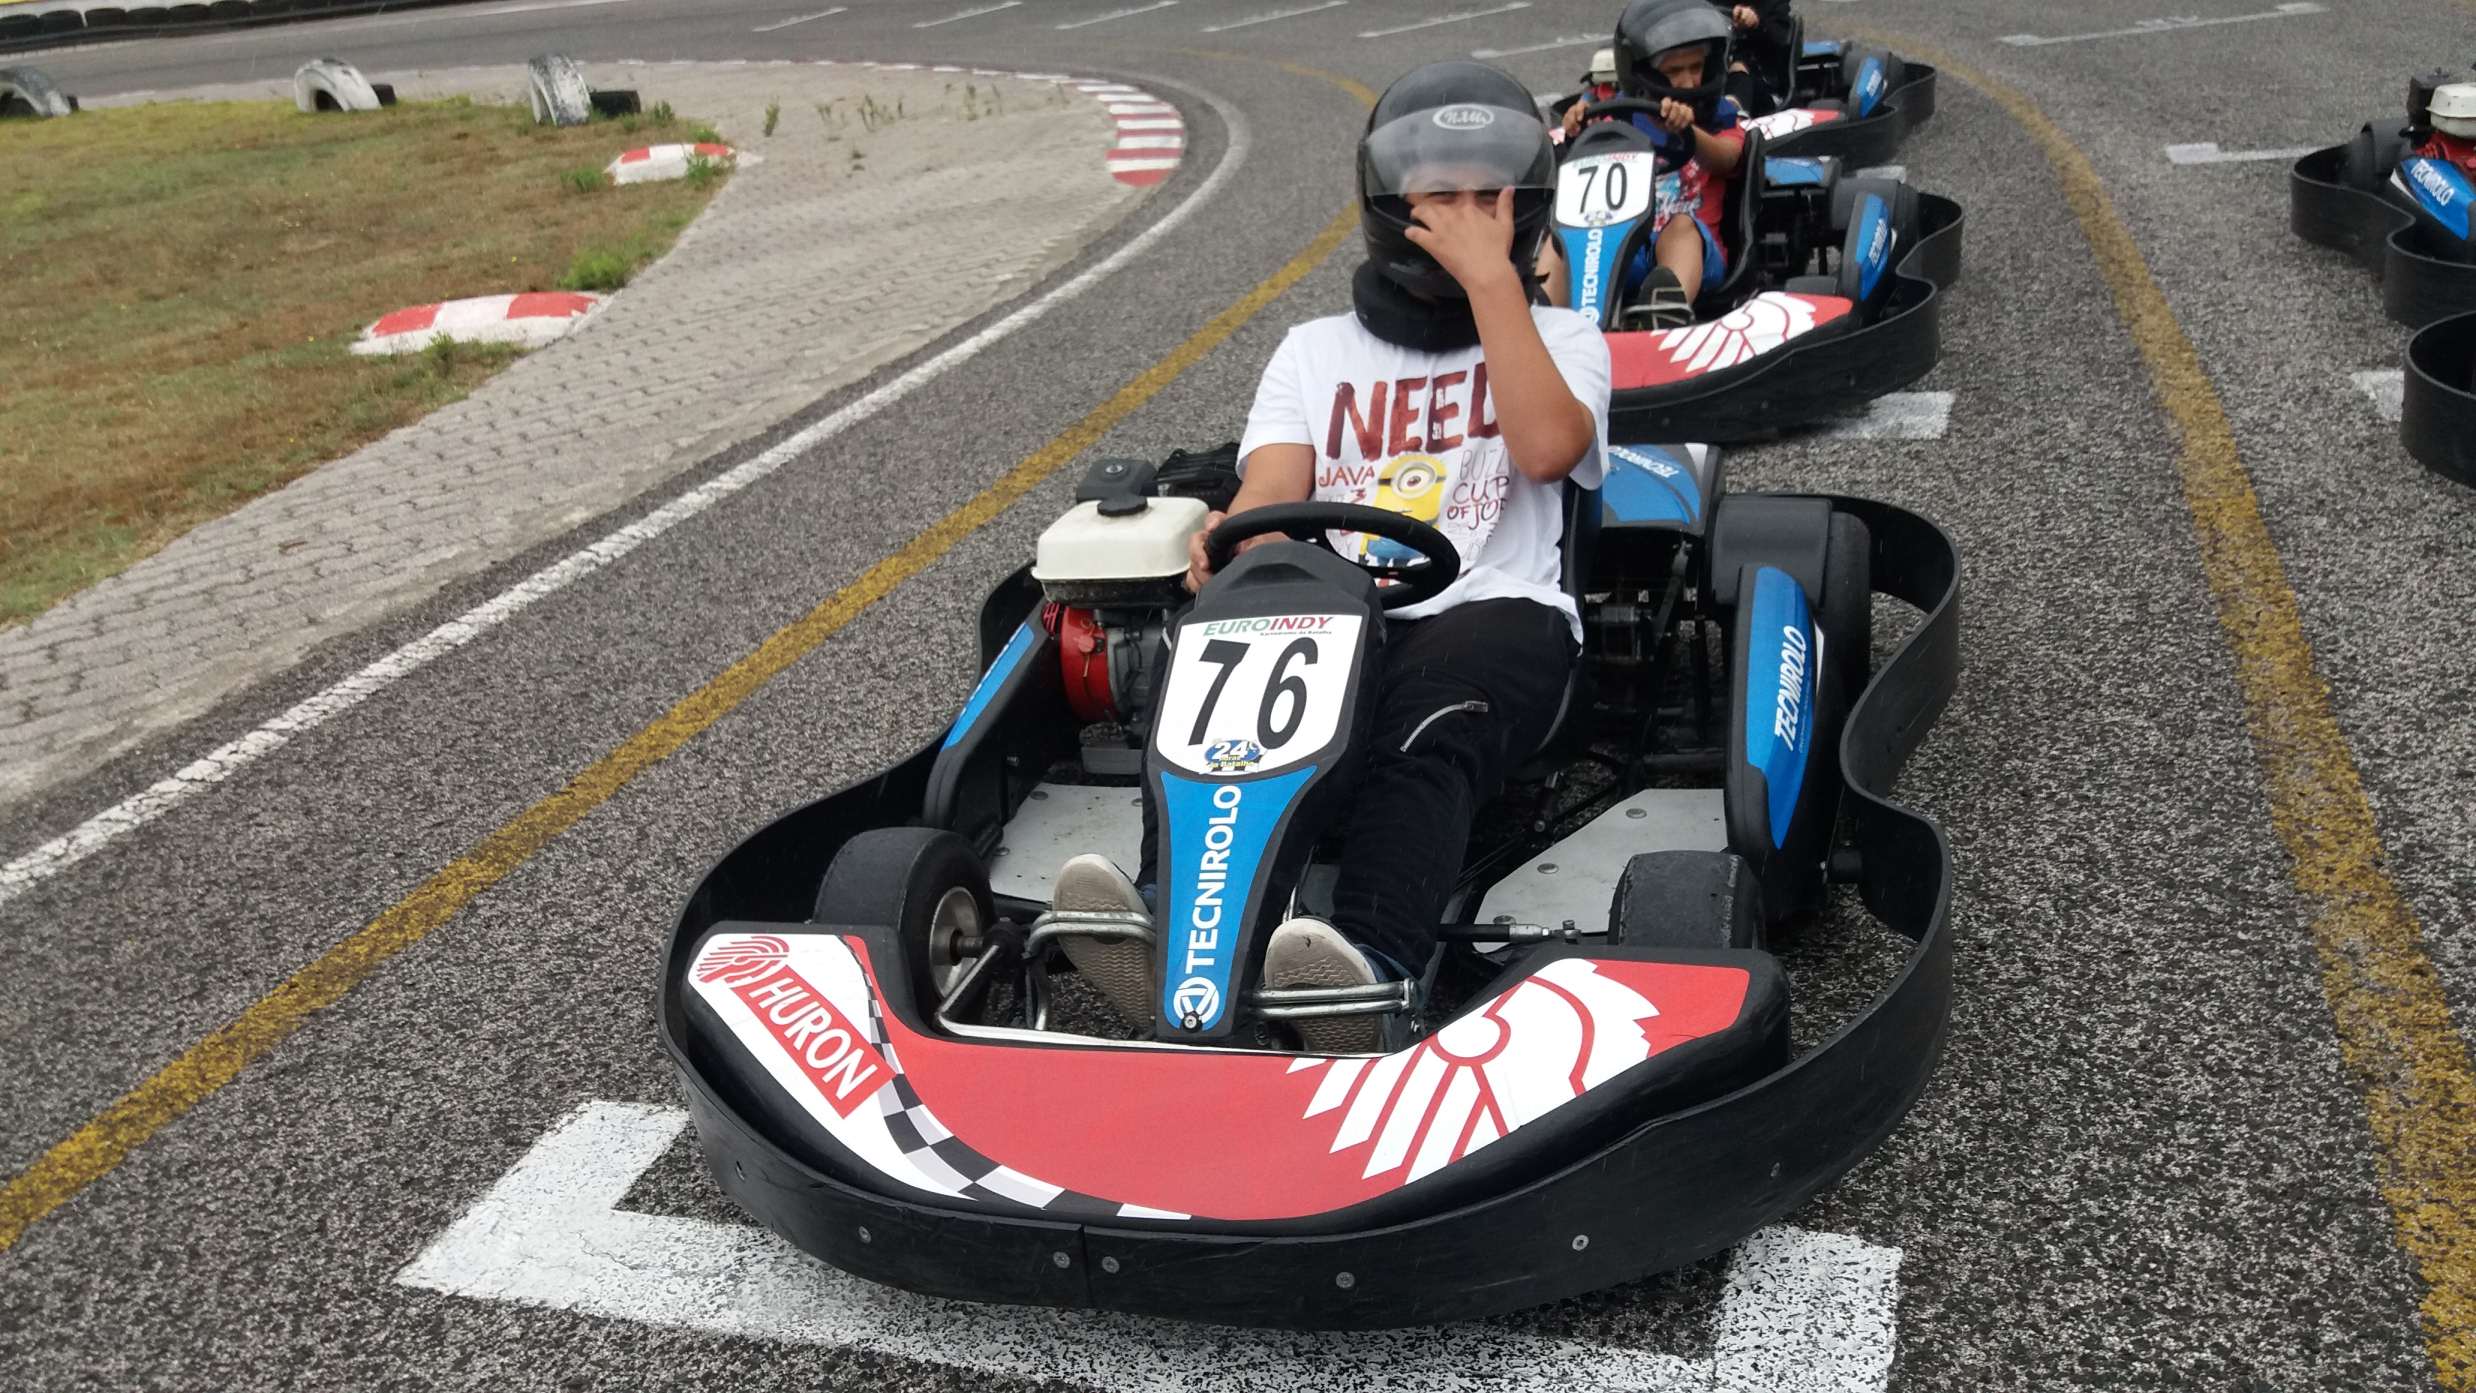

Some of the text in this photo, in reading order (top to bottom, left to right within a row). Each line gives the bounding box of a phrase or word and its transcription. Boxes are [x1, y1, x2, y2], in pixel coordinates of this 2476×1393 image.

[1578, 162, 1628, 215] 70
[1318, 466, 1376, 488] JAVA
[1453, 476, 1510, 504] CUP
[1447, 505, 1470, 520] OF
[1203, 616, 1334, 636] EUROINDY
[1188, 637, 1319, 749] 76
[1773, 625, 1807, 751] TECNIROLO
[1211, 741, 1249, 760] 24
[1184, 785, 1242, 974] TECNIROLO
[748, 977, 879, 1100] HURON
